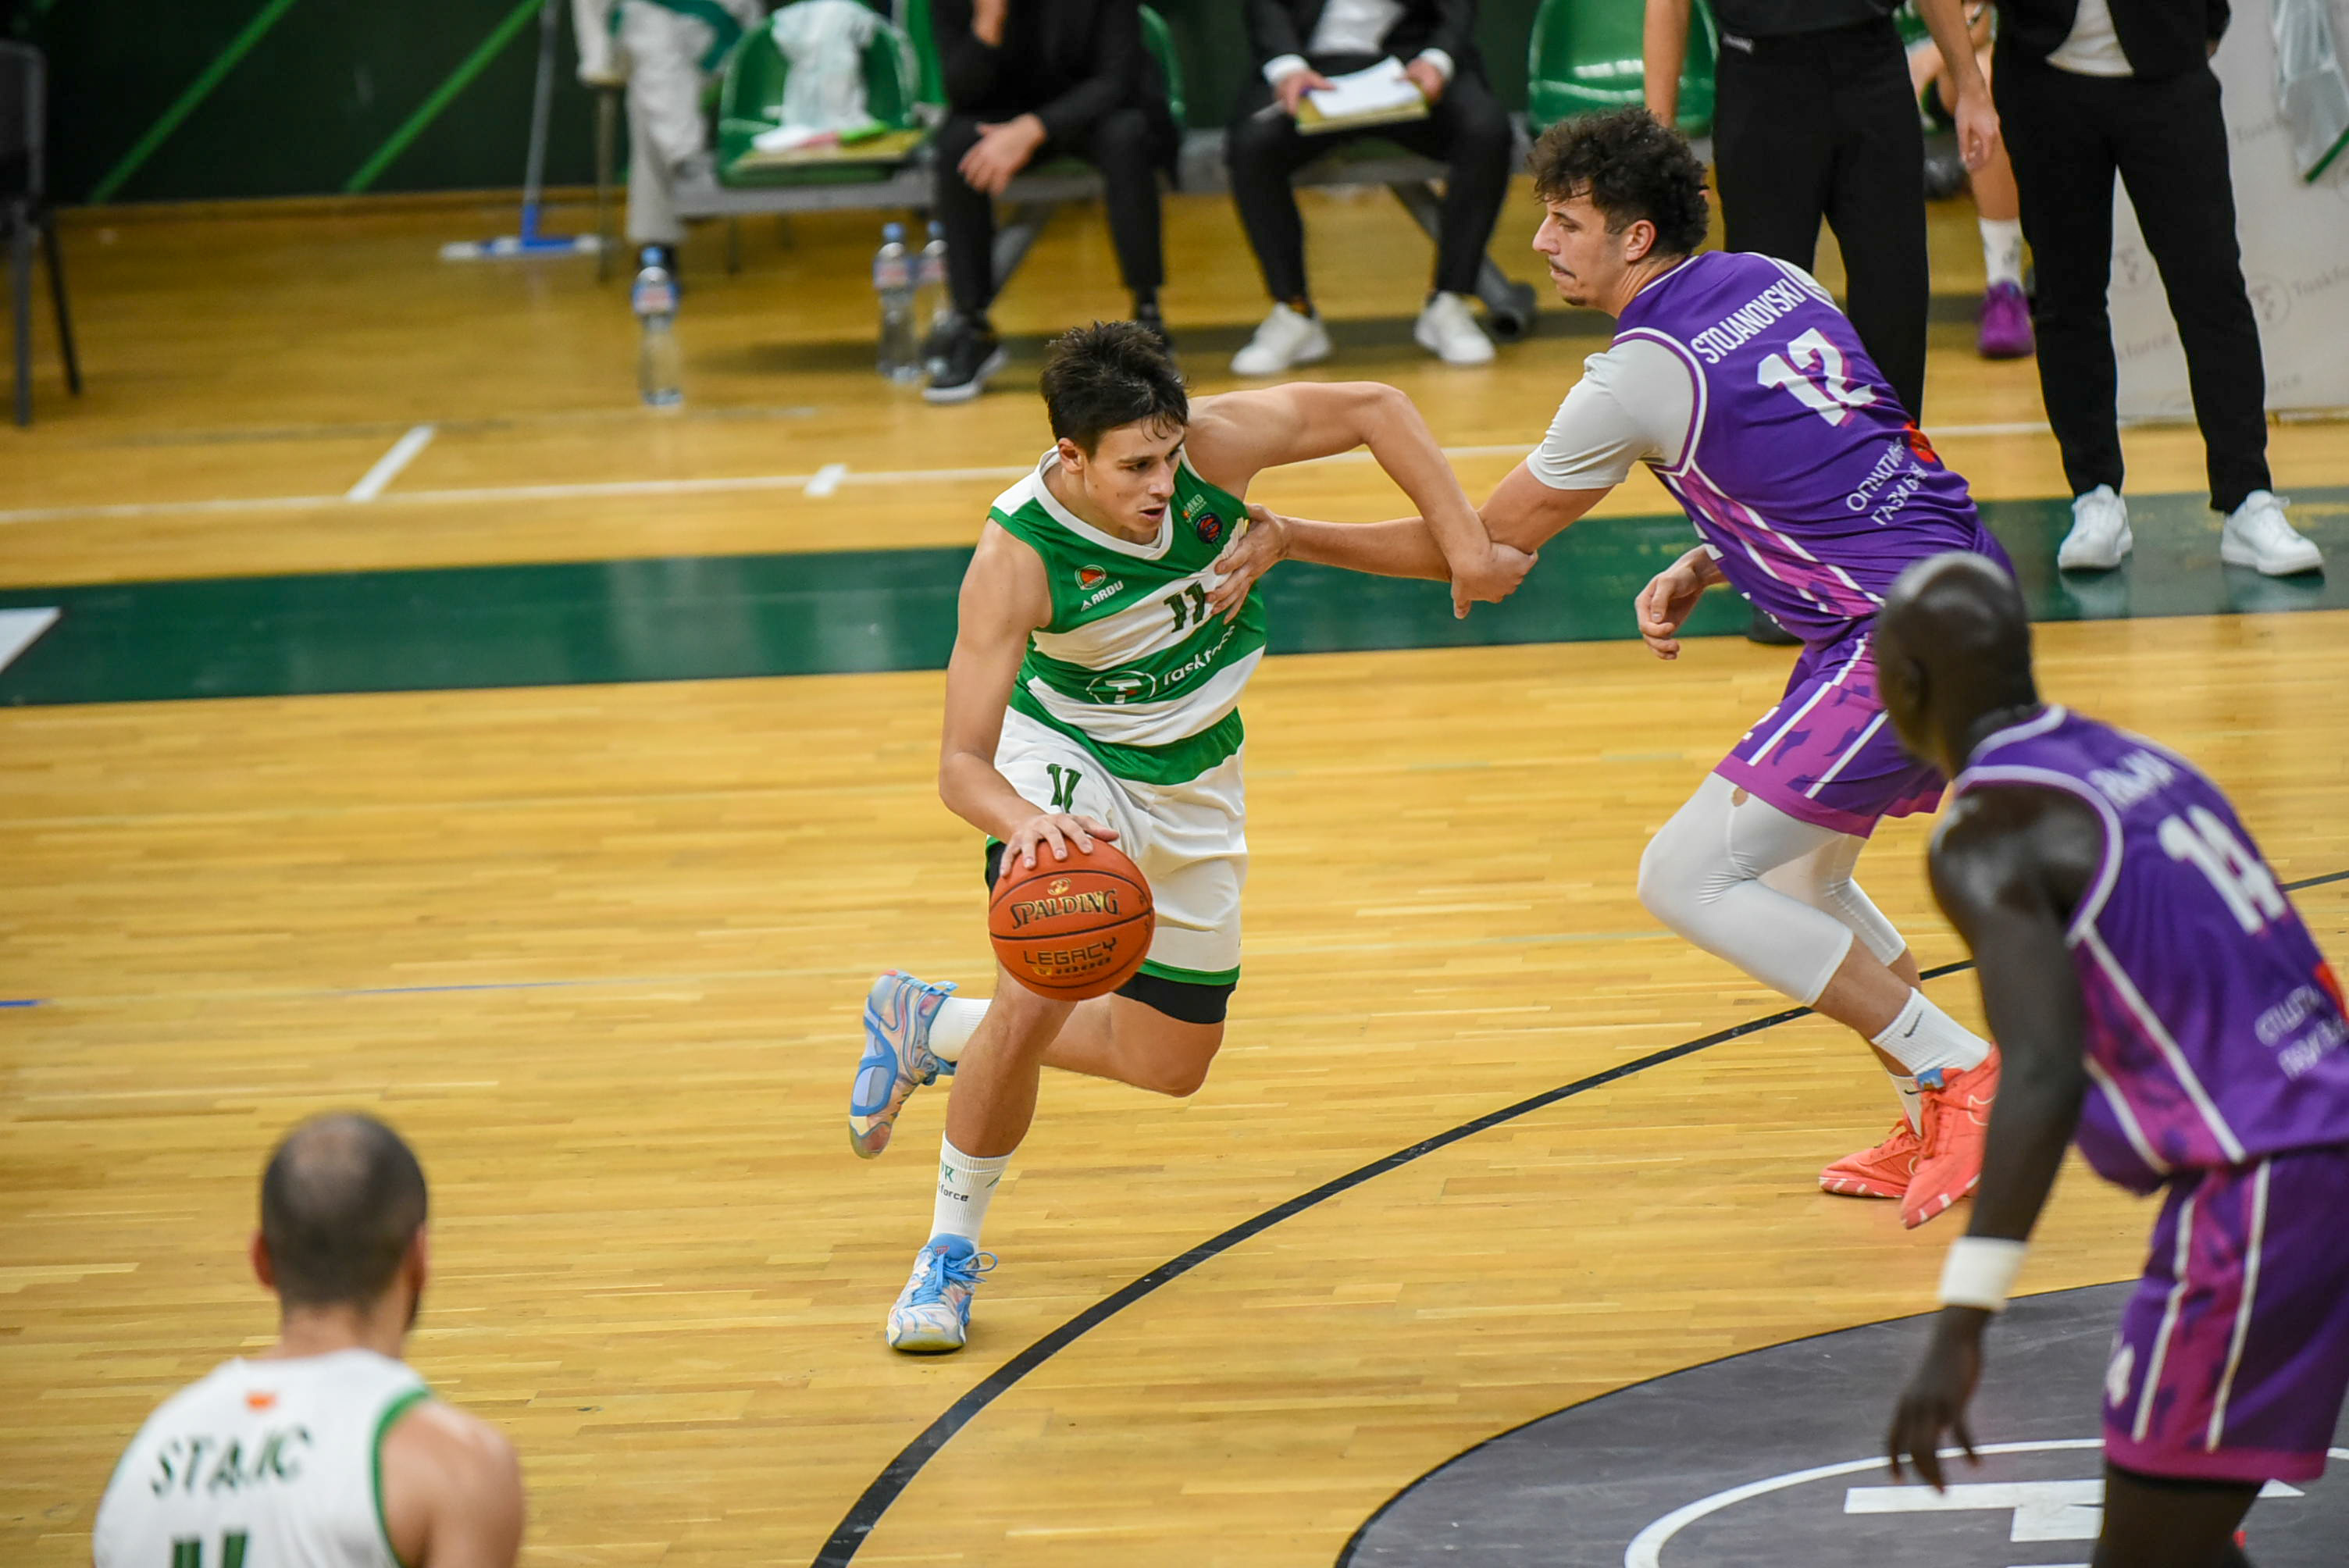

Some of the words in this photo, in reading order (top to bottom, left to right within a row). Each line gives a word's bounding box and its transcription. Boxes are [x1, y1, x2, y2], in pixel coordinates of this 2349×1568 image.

[1690, 278, 1808, 364] STOJANOVSKI
[1756, 327, 1877, 427] 12
[1090, 579, 1124, 605] ARDU
[1163, 579, 1205, 634] 11
[1010, 888, 1120, 930] SPALDING
[1023, 937, 1117, 966] LEGACY
